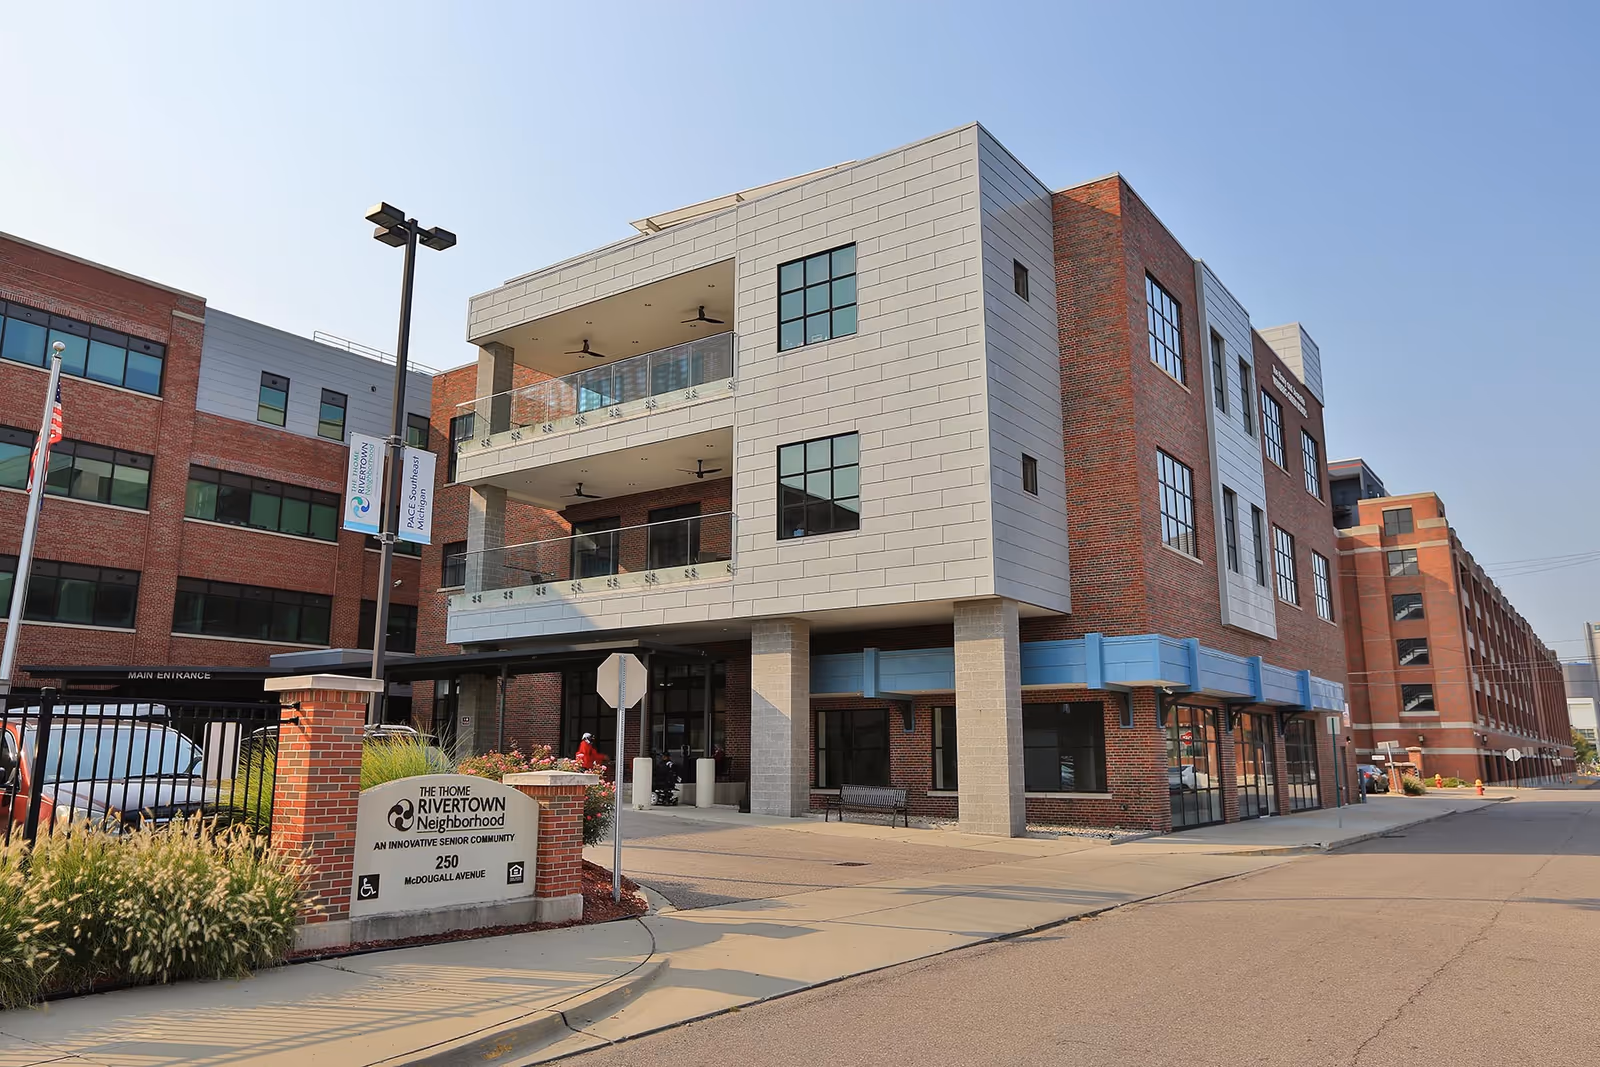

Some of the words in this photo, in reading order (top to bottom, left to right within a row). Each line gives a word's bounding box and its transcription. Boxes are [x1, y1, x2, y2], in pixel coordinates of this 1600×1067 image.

[358, 442, 368, 494] RIVERTOWN
[365, 444, 374, 496] Neighborhood
[409, 456, 420, 501] Southeast
[407, 503, 415, 528] PACE
[417, 488, 427, 530] Michigan
[420, 787, 436, 797] THE
[439, 786, 470, 796] THOME
[418, 796, 506, 814] RIVERTOWN
[417, 813, 504, 833] Neighborhood
[374, 842, 386, 850] AN
[388, 838, 438, 850] INNOVATIVE
[440, 836, 469, 847] SENIOR
[470, 834, 516, 844] COMMUNITY
[436, 854, 458, 870] 250
[404, 874, 454, 885] McDOUGALL
[455, 870, 486, 881] AVENUE
